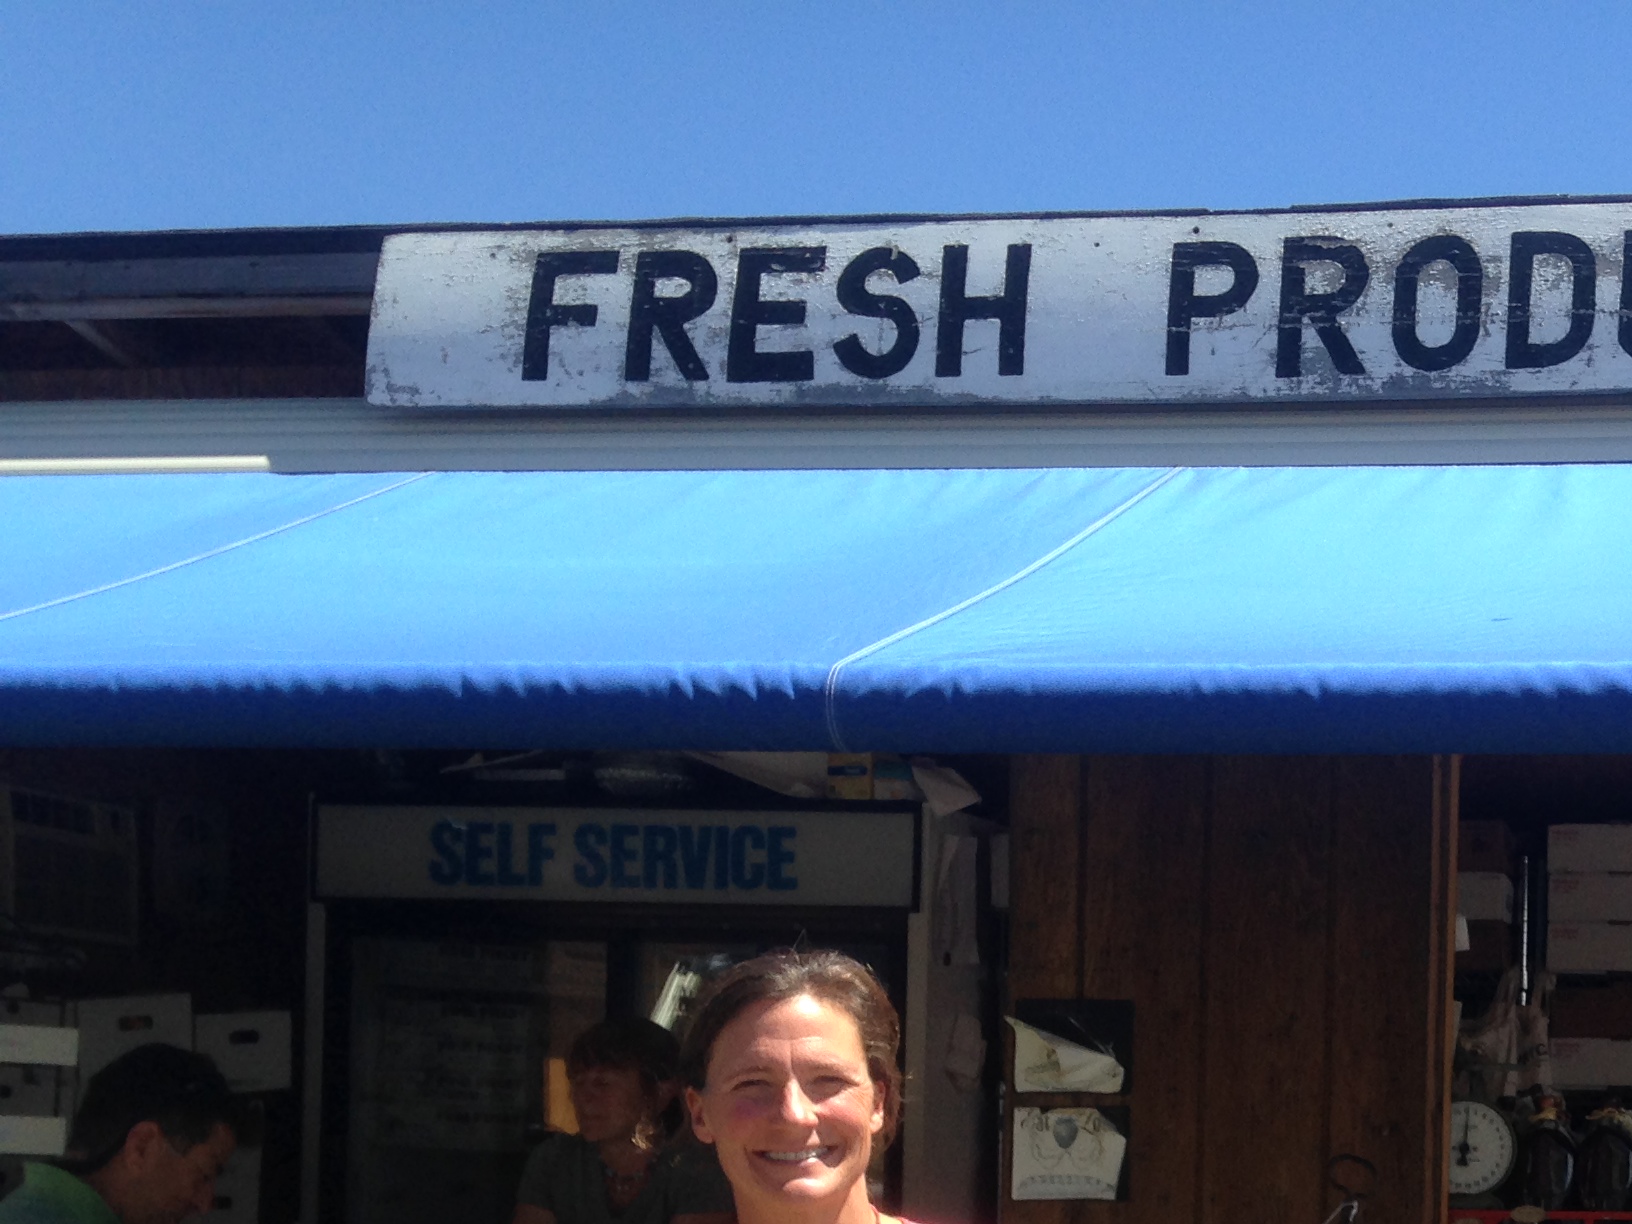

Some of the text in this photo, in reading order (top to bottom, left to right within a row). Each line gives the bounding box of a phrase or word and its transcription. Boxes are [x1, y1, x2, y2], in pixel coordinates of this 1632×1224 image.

[522, 243, 1033, 383] FRESH
[428, 820, 799, 891] SELF SERVICE
